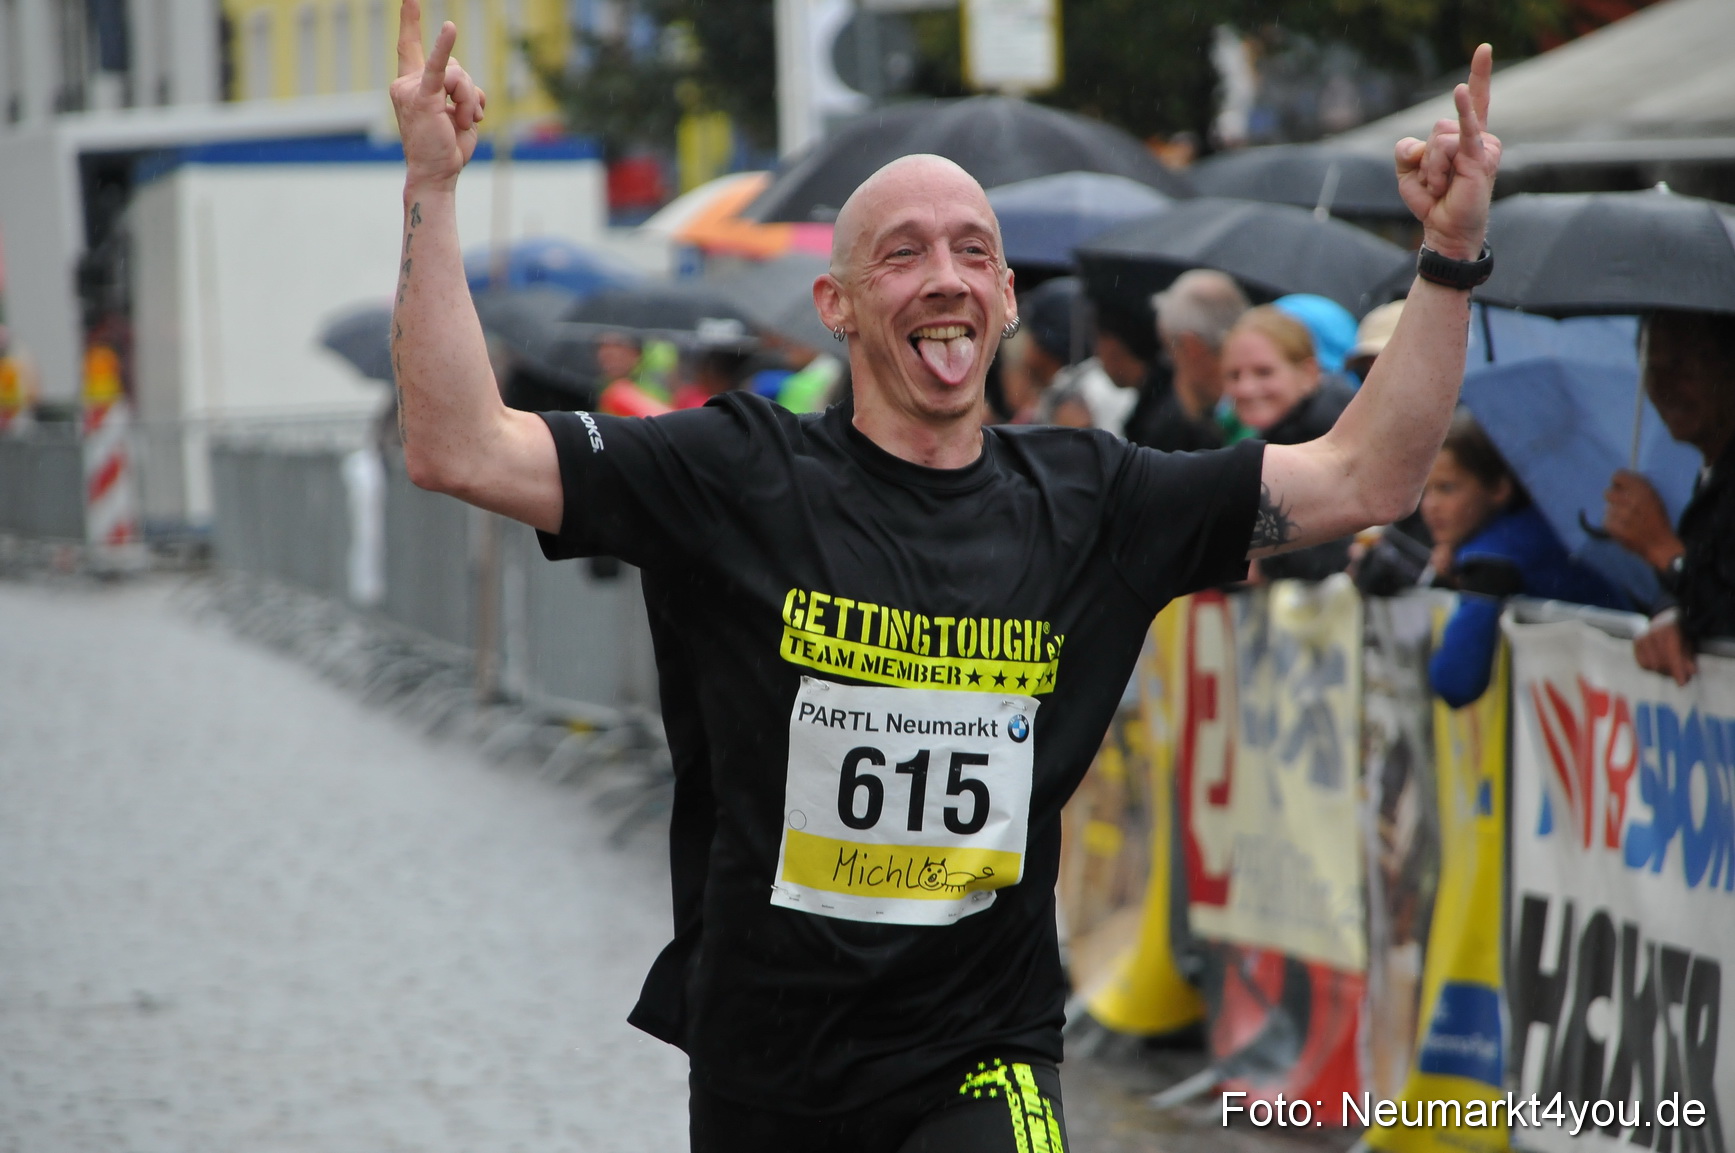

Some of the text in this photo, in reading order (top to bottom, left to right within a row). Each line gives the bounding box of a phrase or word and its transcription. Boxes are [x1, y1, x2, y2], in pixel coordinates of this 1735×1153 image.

[789, 635, 961, 685] TEAM MEMBER
[799, 702, 999, 738] PARTL Neumarkt
[837, 746, 991, 835] 615
